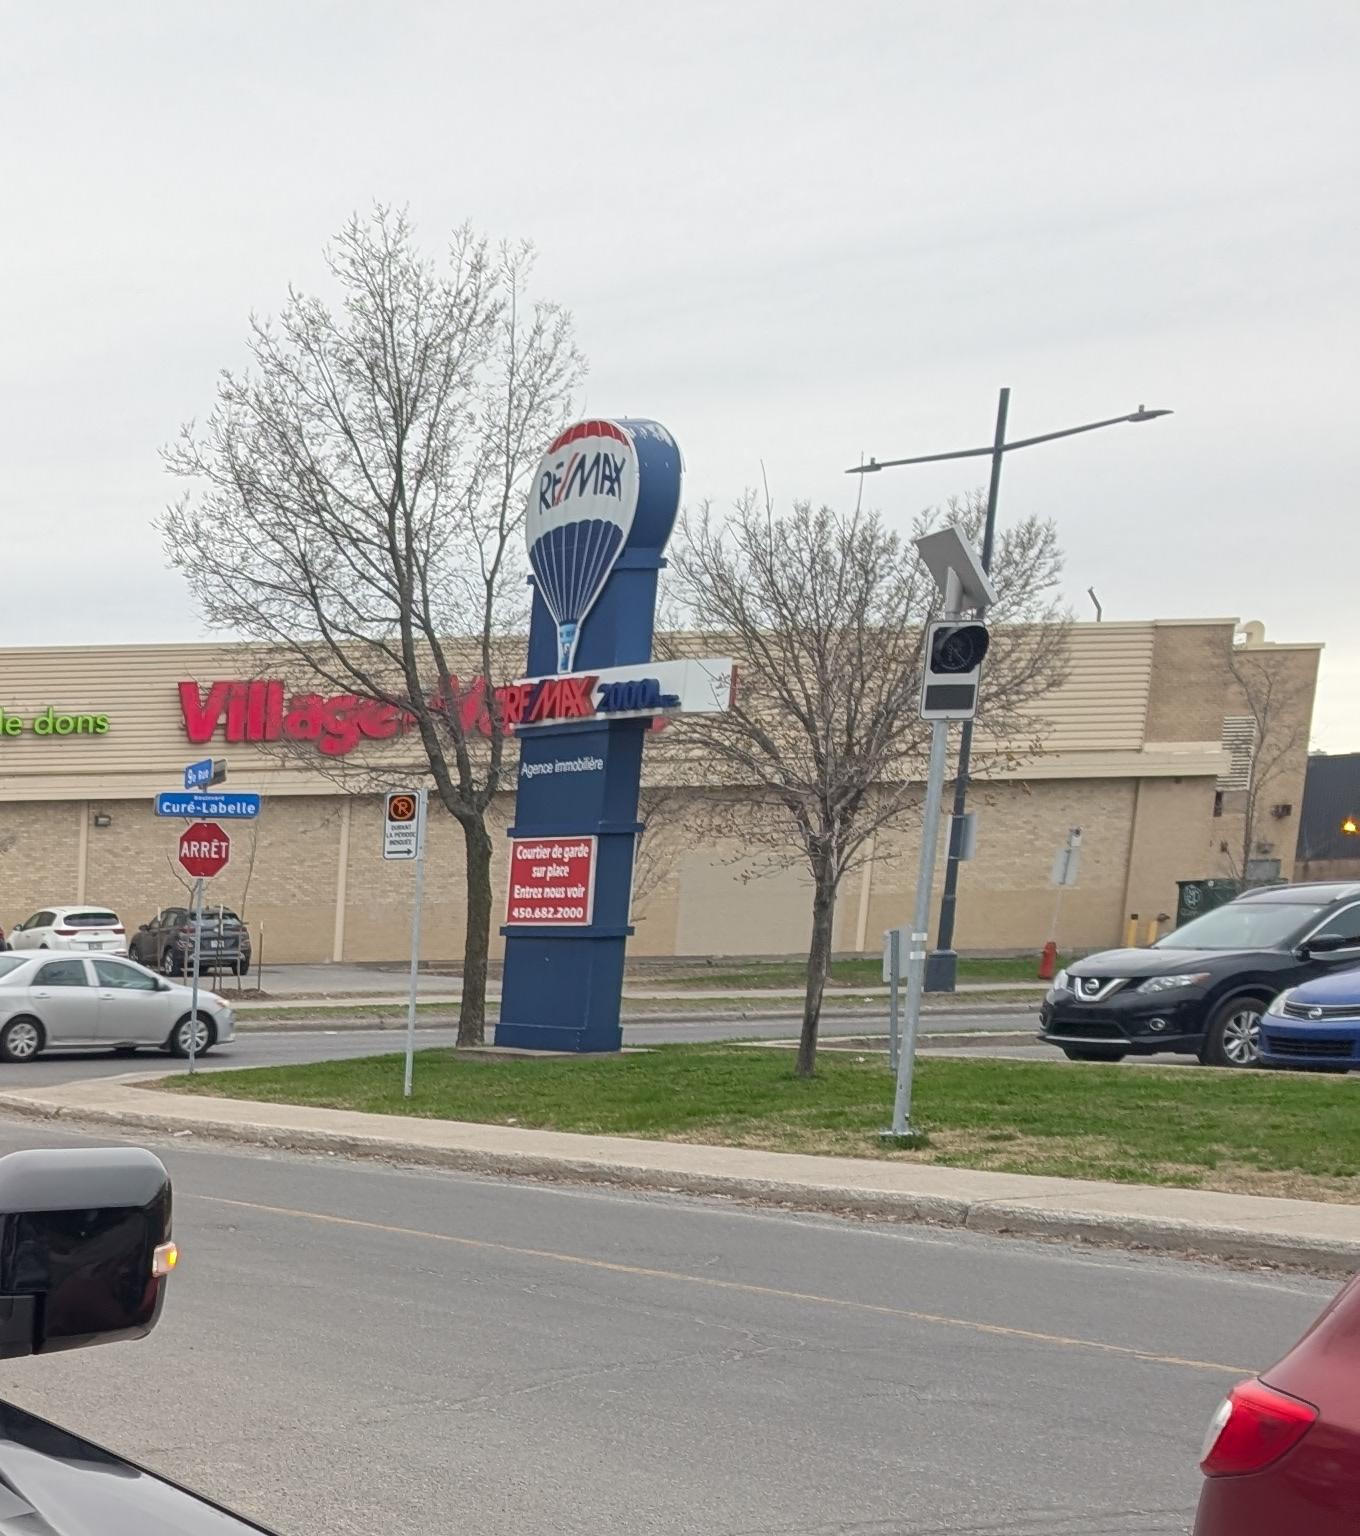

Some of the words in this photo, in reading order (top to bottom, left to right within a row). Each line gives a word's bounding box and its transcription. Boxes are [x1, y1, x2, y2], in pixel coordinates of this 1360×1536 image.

[538, 452, 627, 515] RE/MAX
[34, 705, 111, 736] dons
[177, 680, 400, 755] Village
[521, 761, 553, 778] Agence
[555, 755, 604, 774] immobilière
[162, 801, 256, 814] Curé-Labelle
[180, 839, 228, 859] ARRÊT
[516, 845, 551, 860] Courtier
[552, 844, 563, 859] de
[563, 843, 589, 862] garde
[532, 866, 546, 878] sur
[546, 863, 570, 881] place
[513, 885, 542, 899] Entrez
[543, 887, 566, 898] nous
[566, 884, 585, 898] voir
[512, 907, 584, 919] 450.682.2000
